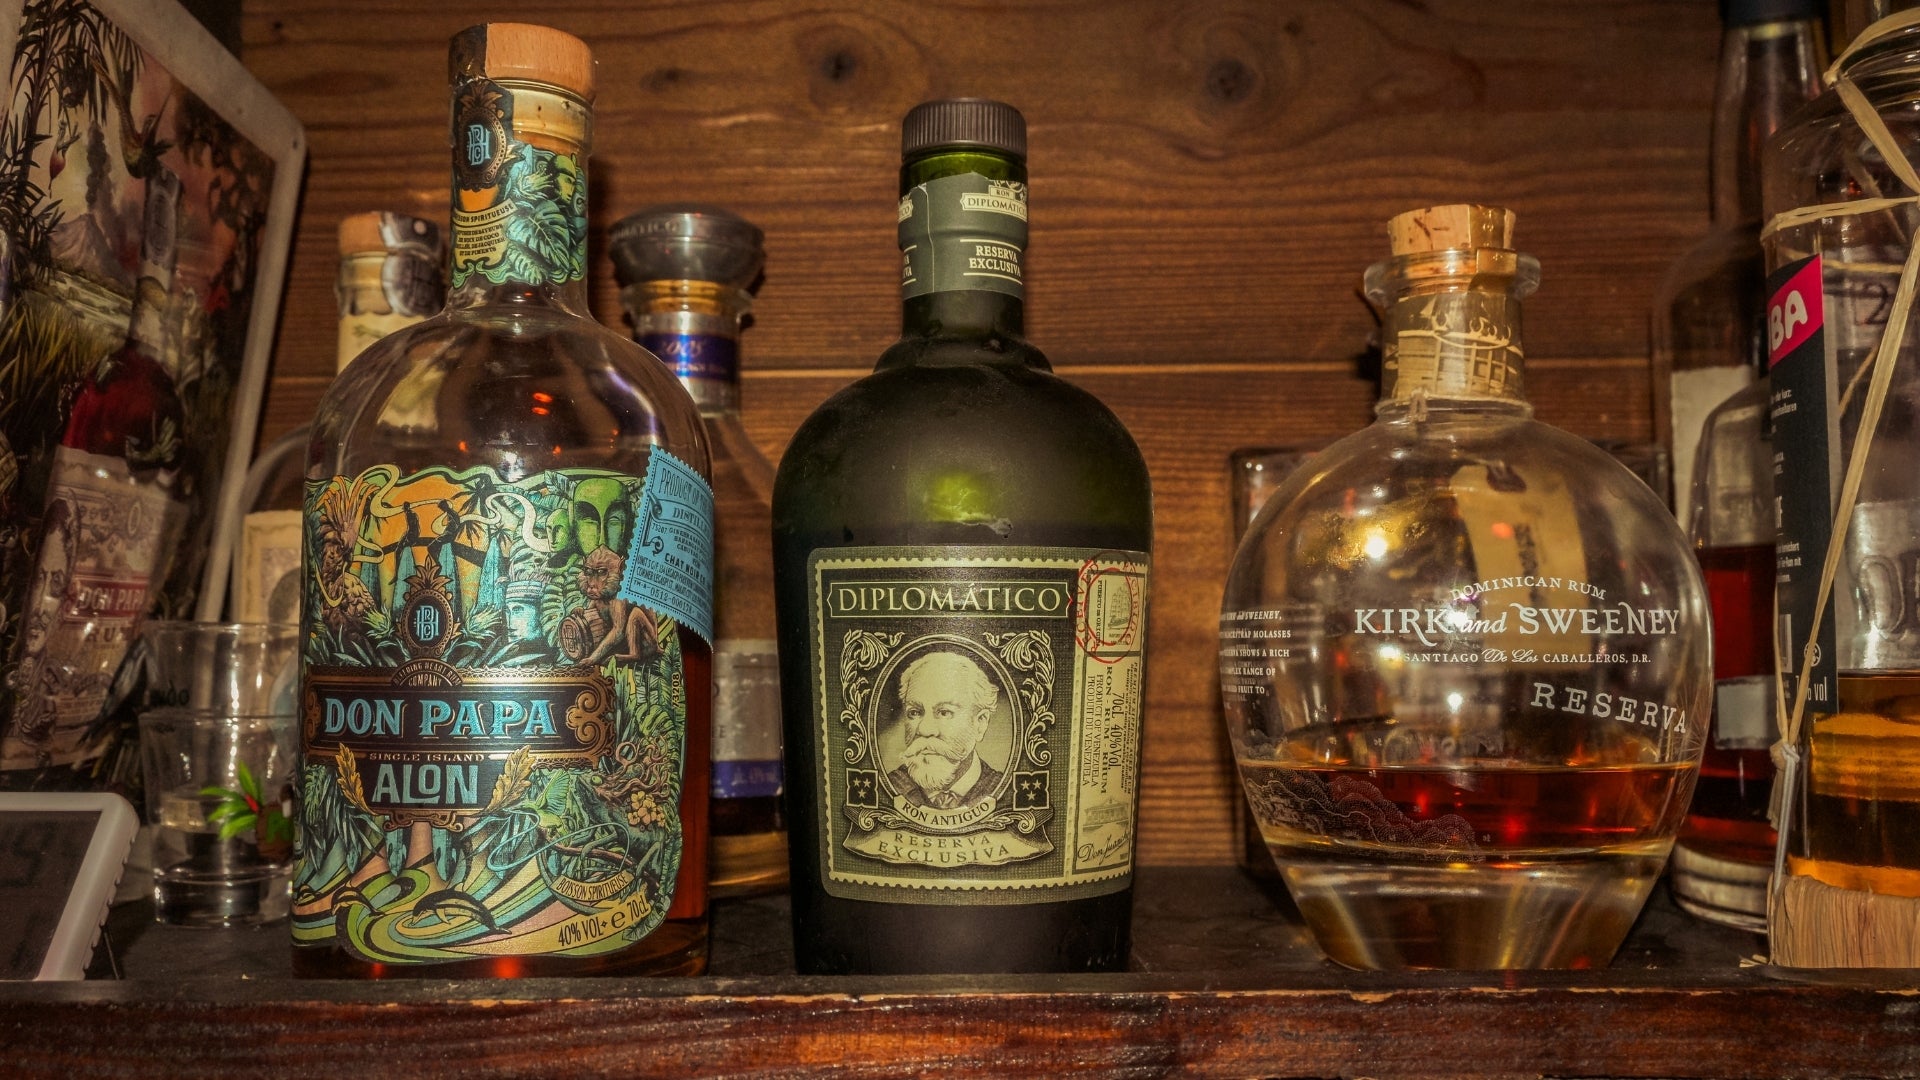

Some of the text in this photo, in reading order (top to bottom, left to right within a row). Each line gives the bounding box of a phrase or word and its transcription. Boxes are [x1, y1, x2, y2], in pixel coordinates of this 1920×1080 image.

[995, 188, 1010, 198] RON
[470, 203, 514, 223] SPIRITUEUSE
[975, 245, 1018, 263] RESERVA
[968, 257, 1021, 278] EXCLUSIVA
[1769, 289, 1808, 351] BA
[658, 467, 692, 500] PRODUCT
[664, 552, 685, 569] CHAT
[78, 586, 113, 611] DON
[838, 583, 1061, 612] DIPLOMÁTICO
[1449, 576, 1607, 601] DOMINICAN RUM
[1245, 610, 1282, 621] SWEENEY,
[1353, 601, 1681, 647] KIRK and SWEENEY
[1252, 629, 1292, 639] MOLASSES
[1239, 648, 1260, 657] SHOWS
[1261, 648, 1267, 657] A
[1269, 649, 1290, 657] RICH
[1403, 652, 1479, 664] SANTIAGO
[1481, 648, 1508, 663] De
[1542, 653, 1629, 665] CABALLEROS,
[1631, 653, 1652, 664] D.R.
[408, 673, 442, 687] COMPANY
[446, 670, 462, 686] RUM
[1105, 666, 1113, 696] RON
[1242, 667, 1264, 676] RANGE
[1265, 667, 1276, 676] OF
[1086, 675, 1096, 715] PRODUIT
[1238, 685, 1254, 694] FRUIT
[1255, 686, 1265, 694] TO
[323, 697, 557, 738] DON PAPA
[1530, 682, 1687, 734] RESERVA
[1091, 674, 1104, 788] PRODUCT OF VENEZUELA
[369, 752, 485, 763] SINGLE ISLAND
[1082, 732, 1092, 787] VENEZUELA
[371, 763, 479, 805] ALON
[901, 801, 990, 826] RON ANTIGUO
[877, 840, 1010, 864] EXCLUSIVA
[893, 831, 991, 849] RESERVA
[556, 873, 629, 900] BOISSON SPIRITUEUSE
[557, 920, 582, 947] 40%
[581, 916, 604, 940] VOL
